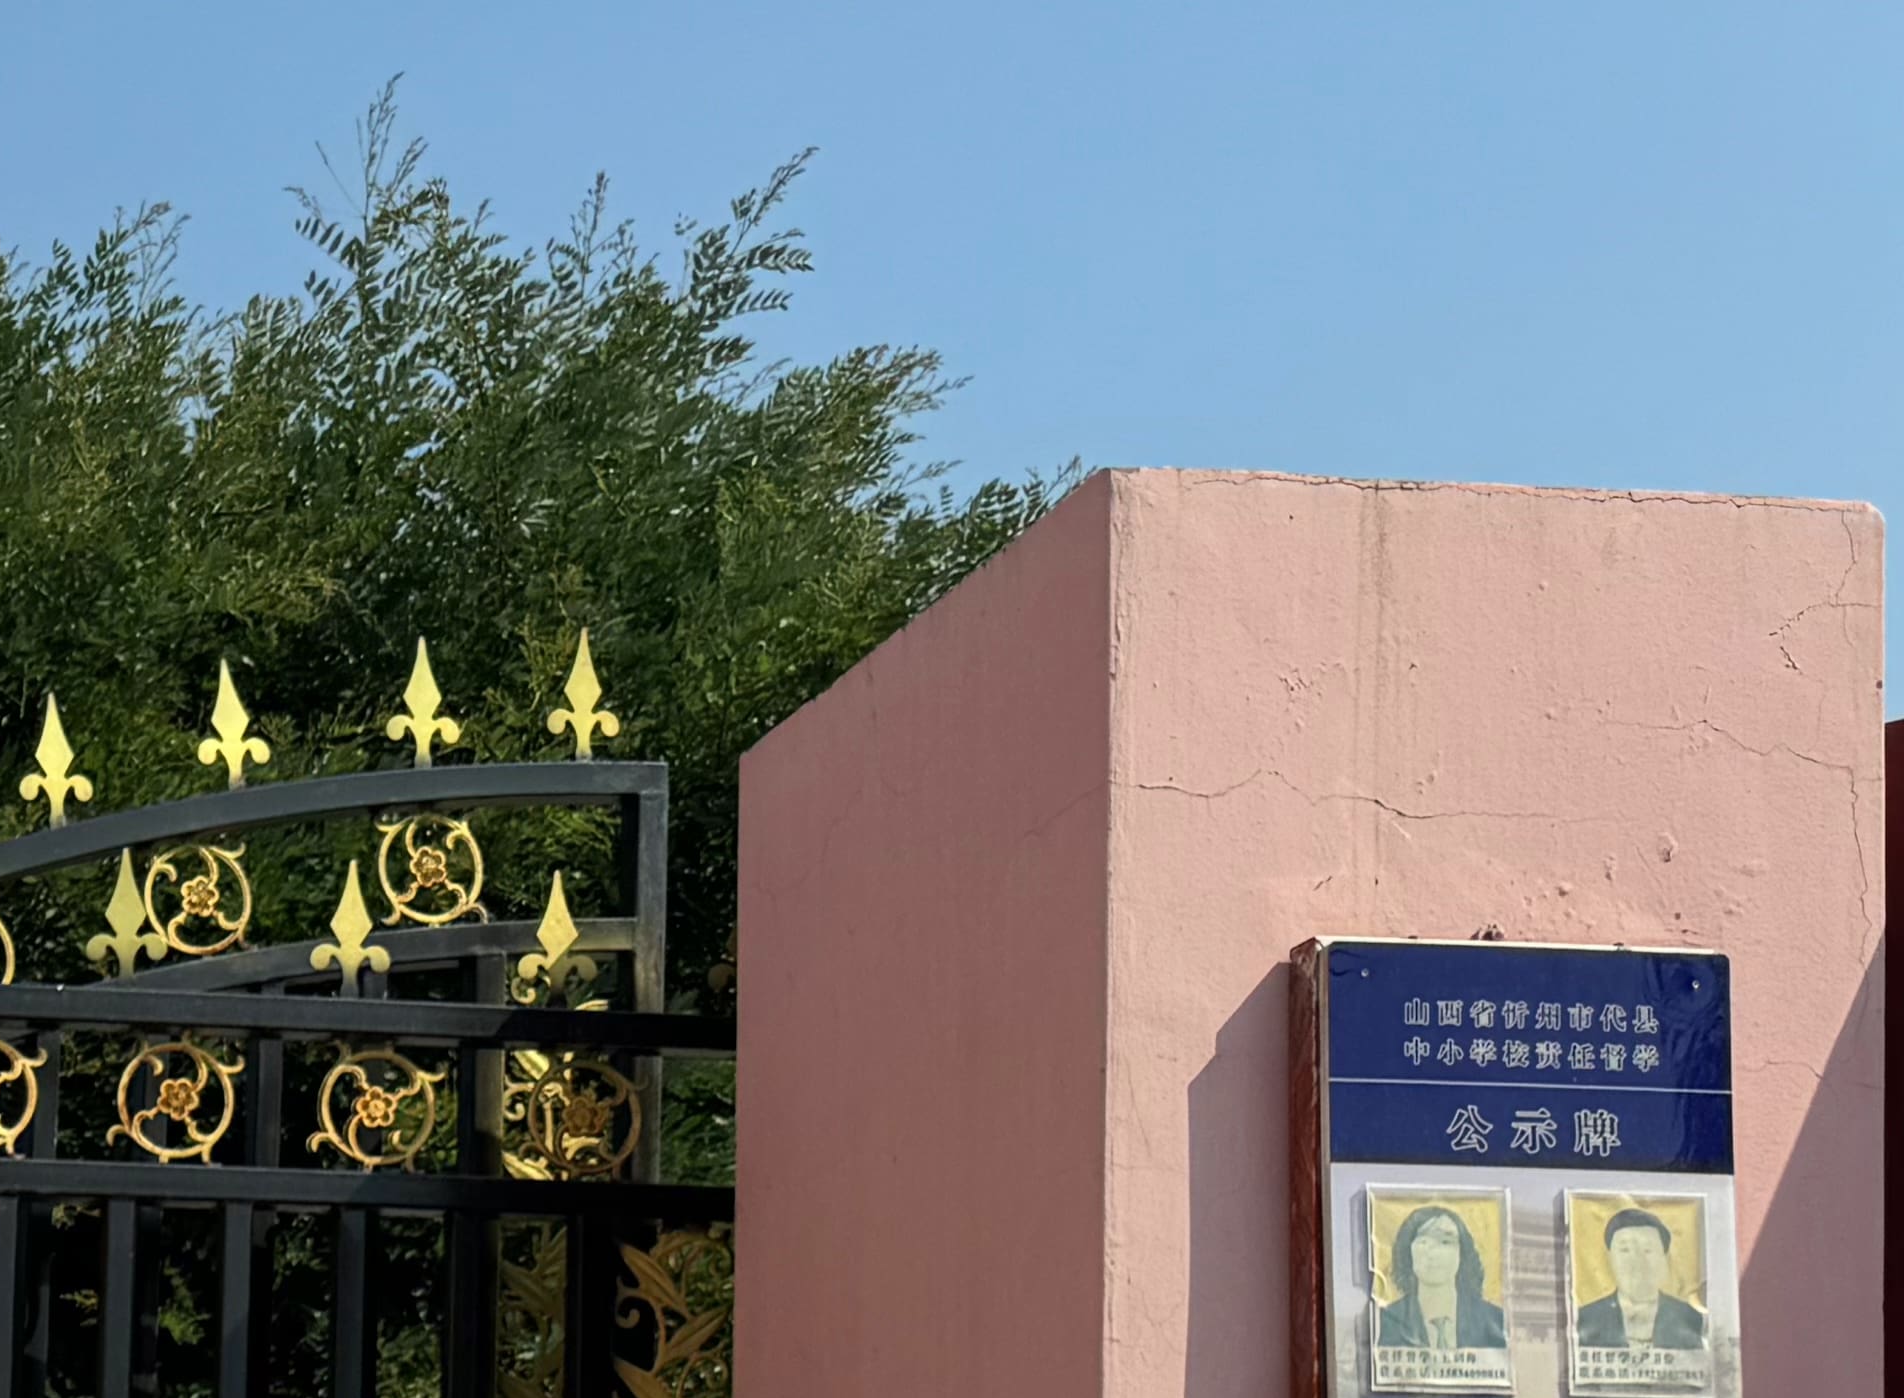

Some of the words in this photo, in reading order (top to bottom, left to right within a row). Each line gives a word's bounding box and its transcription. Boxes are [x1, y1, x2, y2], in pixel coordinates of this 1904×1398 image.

[1404, 997, 1660, 1034] 山西省忻州市代县
[1404, 1037, 1660, 1072] 中小学校责任督学
[1446, 1105, 1622, 1157] 公示牌
